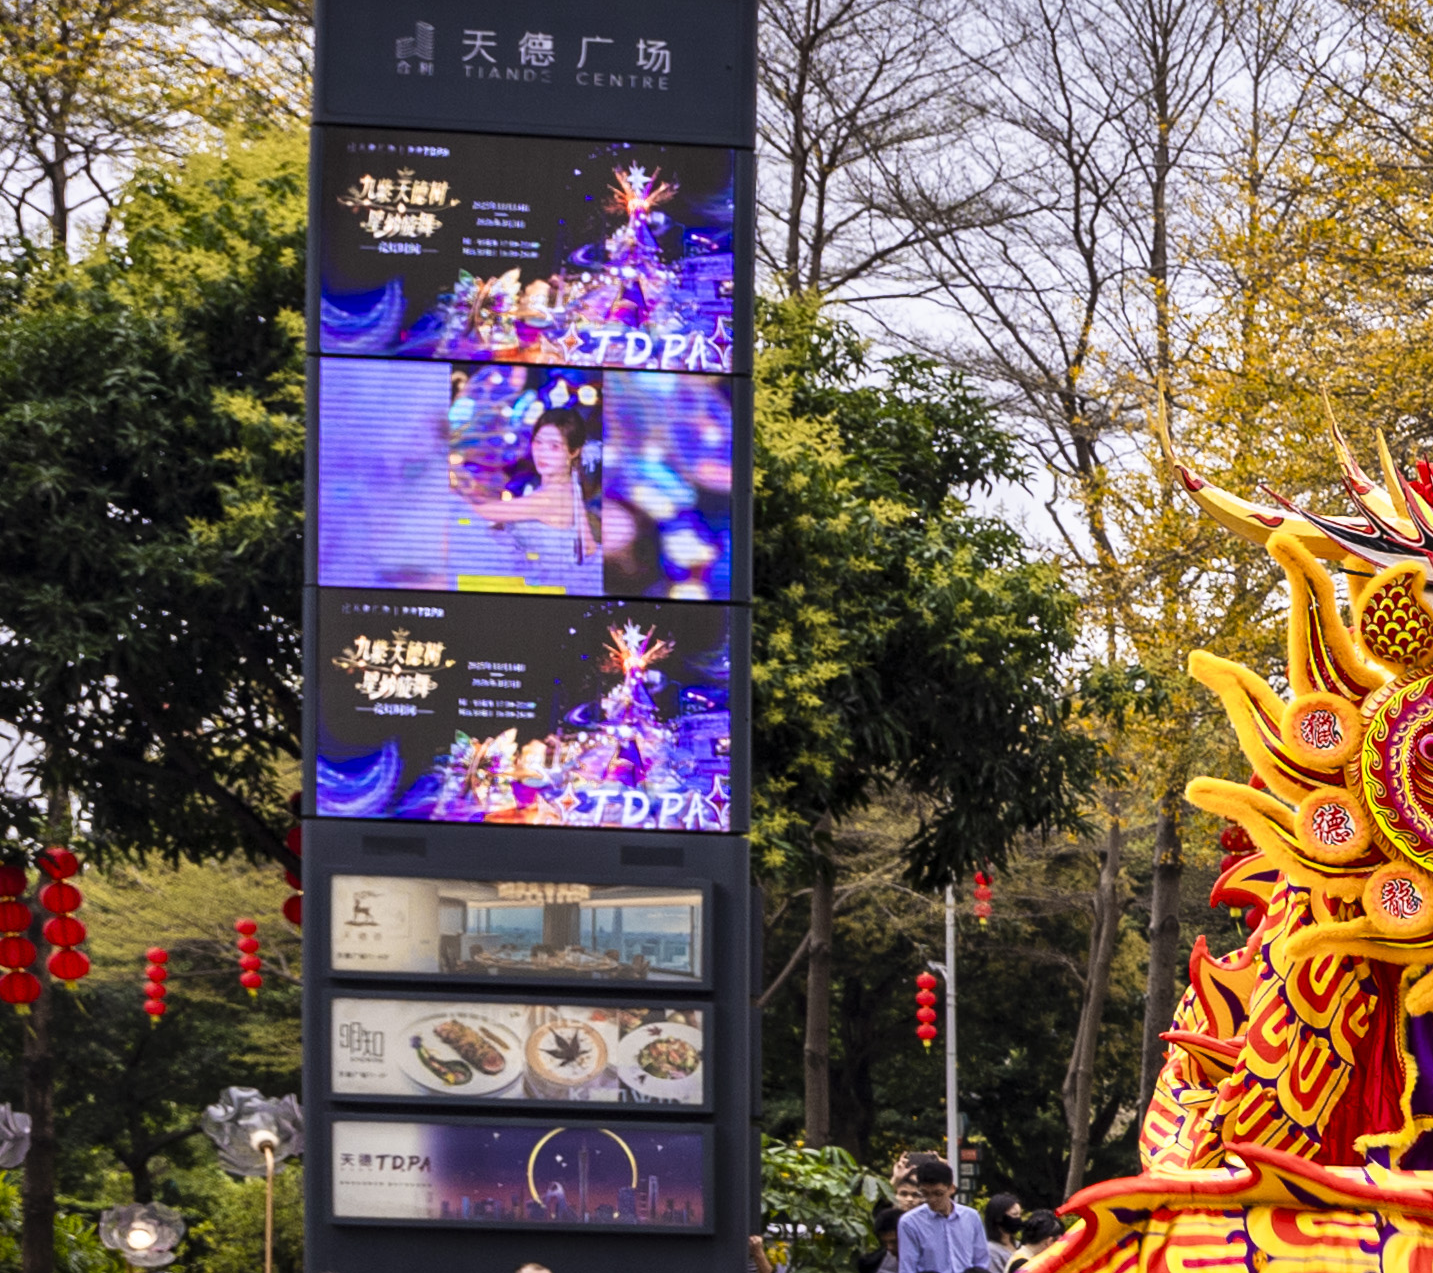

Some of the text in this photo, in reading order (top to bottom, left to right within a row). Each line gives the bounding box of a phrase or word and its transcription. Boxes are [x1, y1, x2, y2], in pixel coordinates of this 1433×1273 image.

[462, 29, 671, 74] 天德广场
[576, 71, 670, 91] CENTRE
